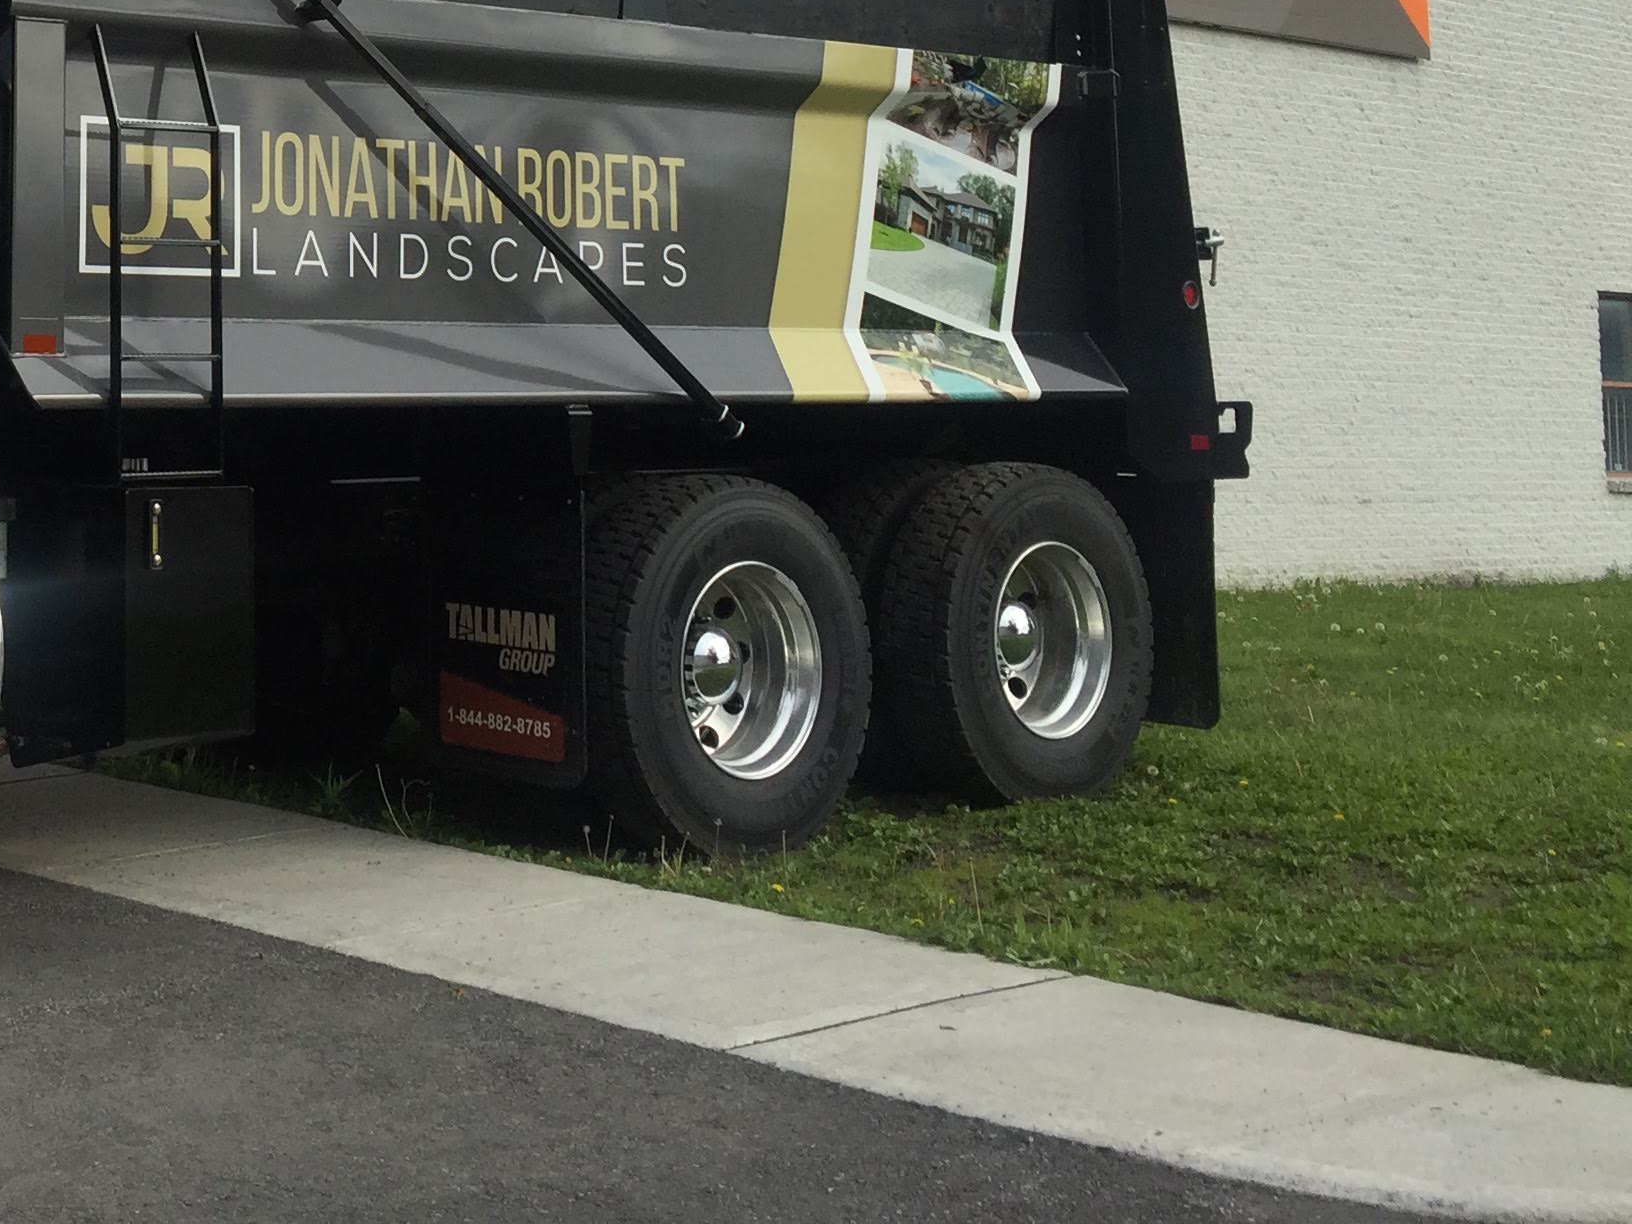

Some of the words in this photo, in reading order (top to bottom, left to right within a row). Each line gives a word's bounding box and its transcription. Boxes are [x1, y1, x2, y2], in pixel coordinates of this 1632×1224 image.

[252, 130, 504, 225] JONATHAN
[517, 147, 685, 233] ROBERT
[253, 228, 687, 288] LANDSCAPES
[445, 602, 556, 652] TALLMAN
[499, 648, 556, 676] GROUP
[447, 706, 552, 739] 1-844-882-8785
